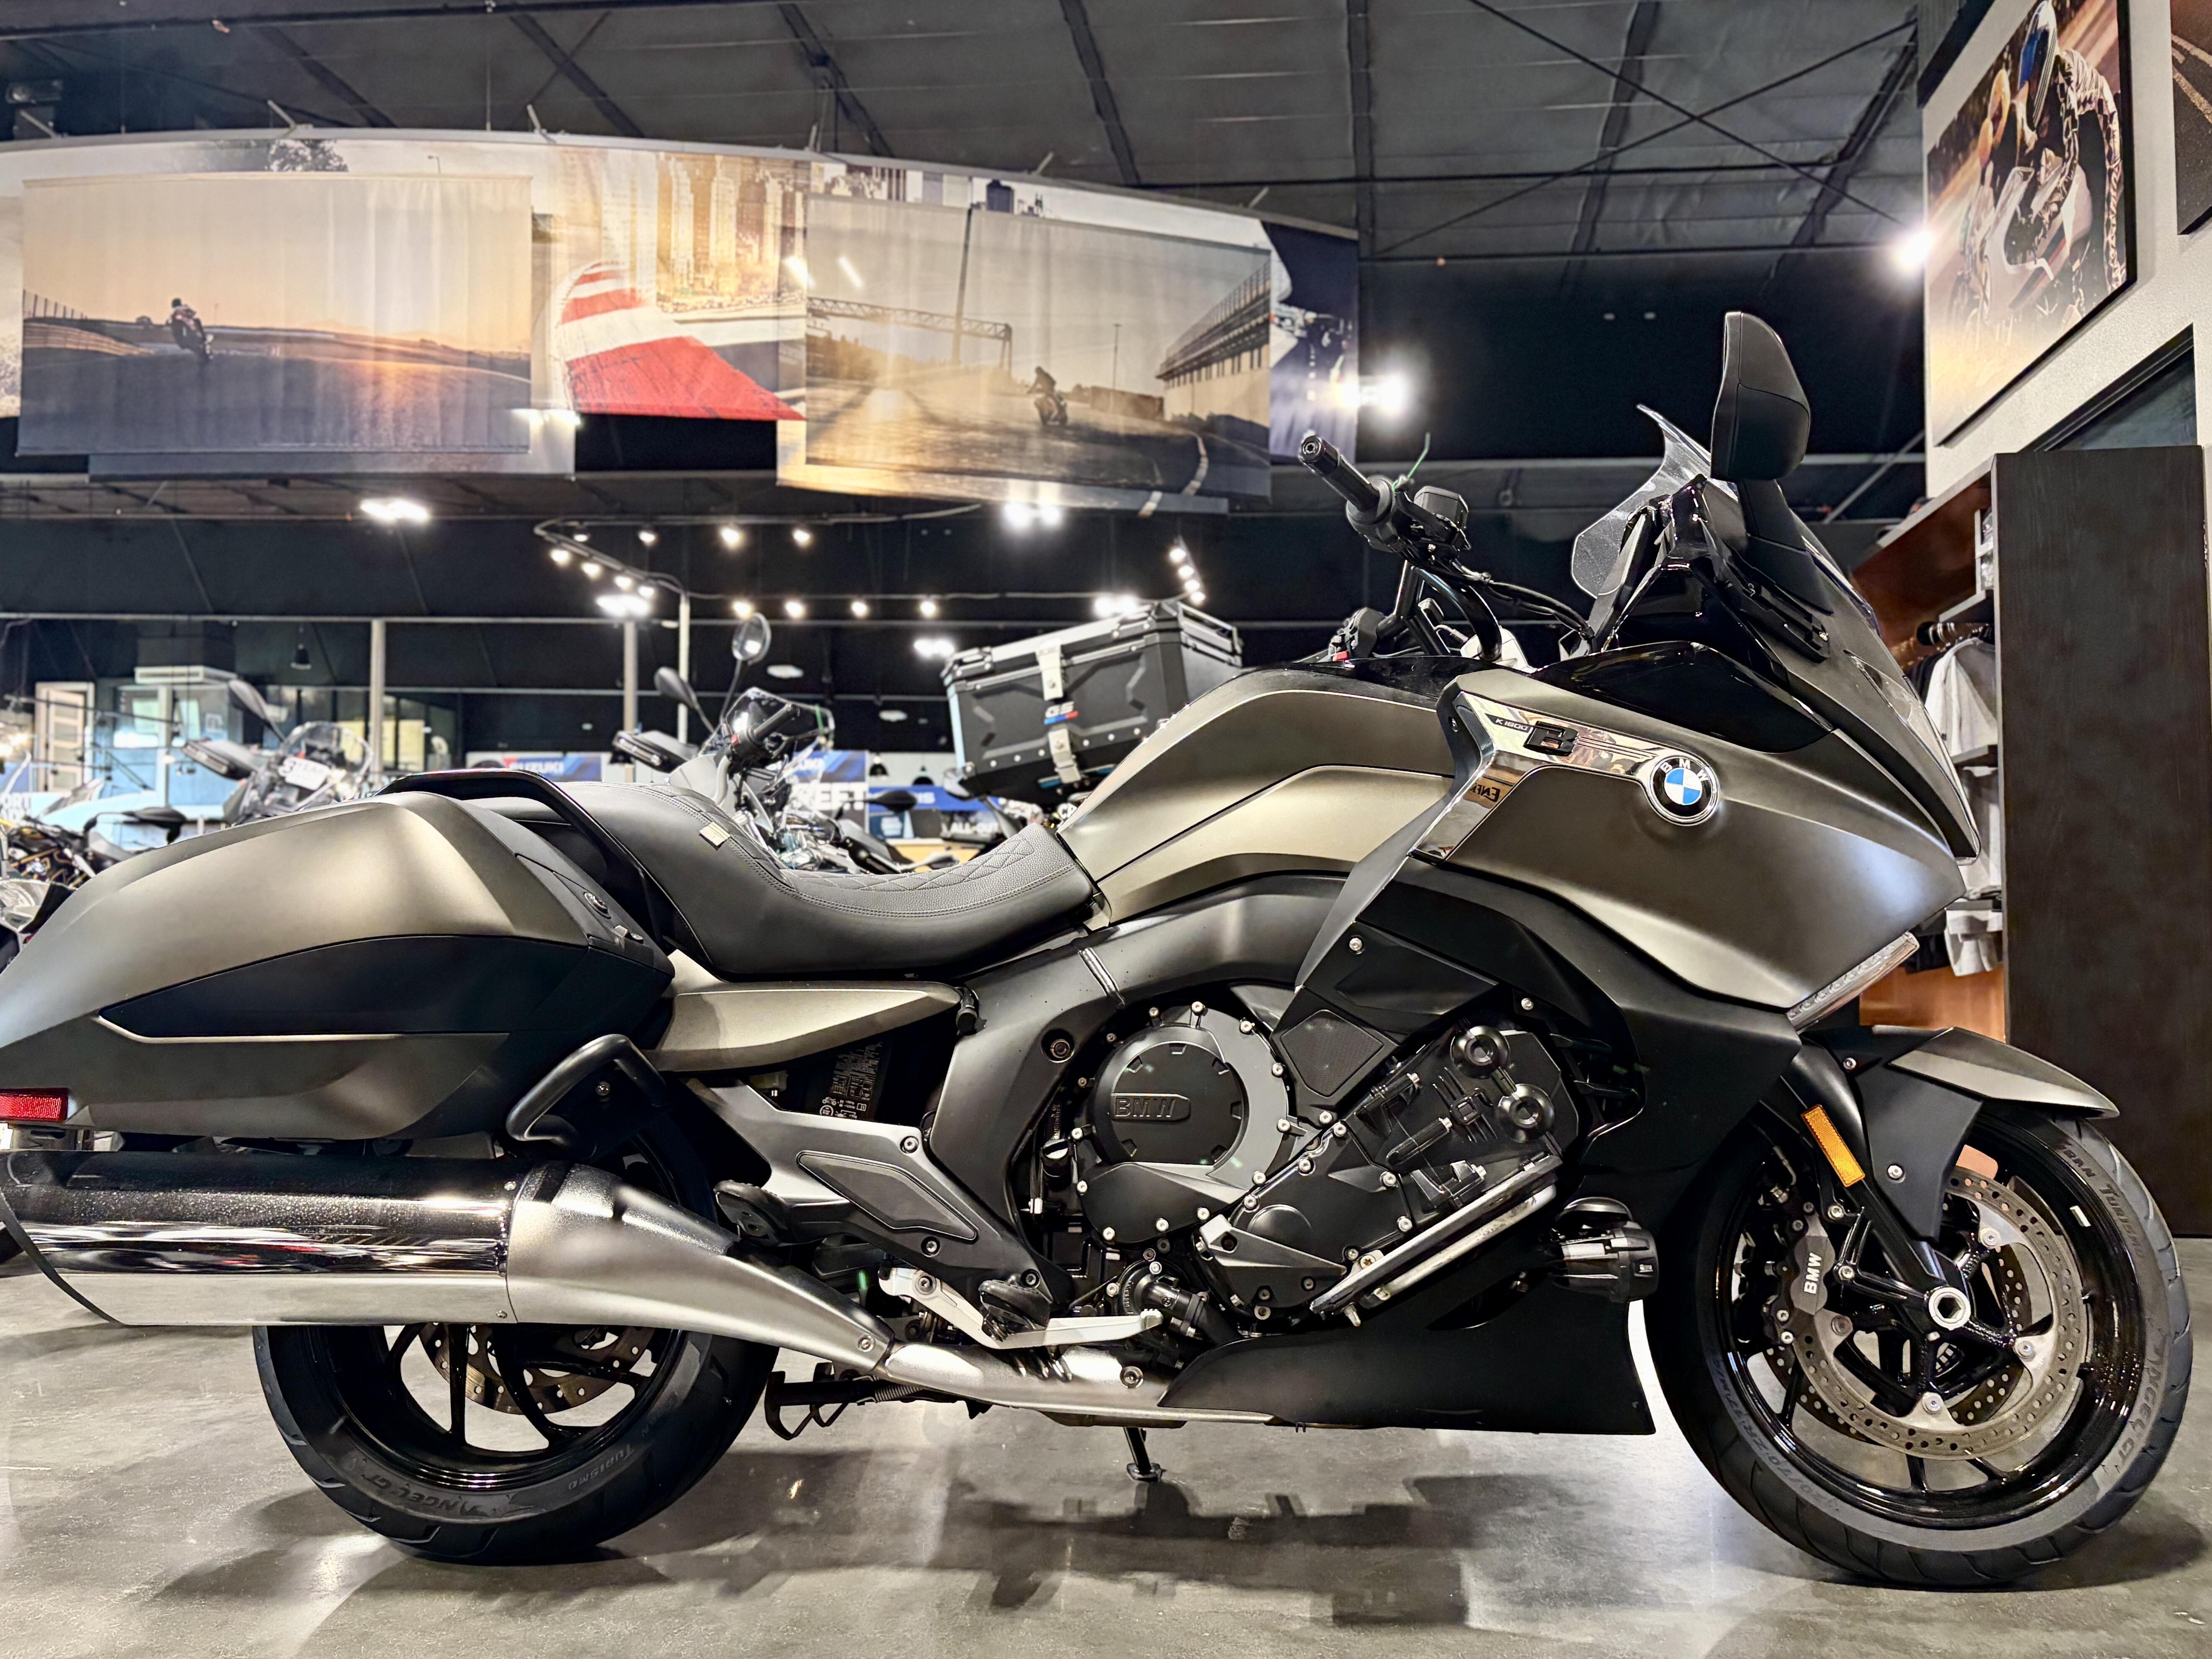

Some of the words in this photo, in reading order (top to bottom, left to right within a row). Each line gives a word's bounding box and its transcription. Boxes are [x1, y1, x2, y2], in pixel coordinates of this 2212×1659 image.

[1045, 701, 1074, 718] GS
[1504, 721, 1528, 731] 1600
[1523, 721, 1578, 756] B
[1660, 758, 1709, 782] BMW
[1115, 1097, 1175, 1117] BMW
[1804, 1252, 1822, 1294] BMW
